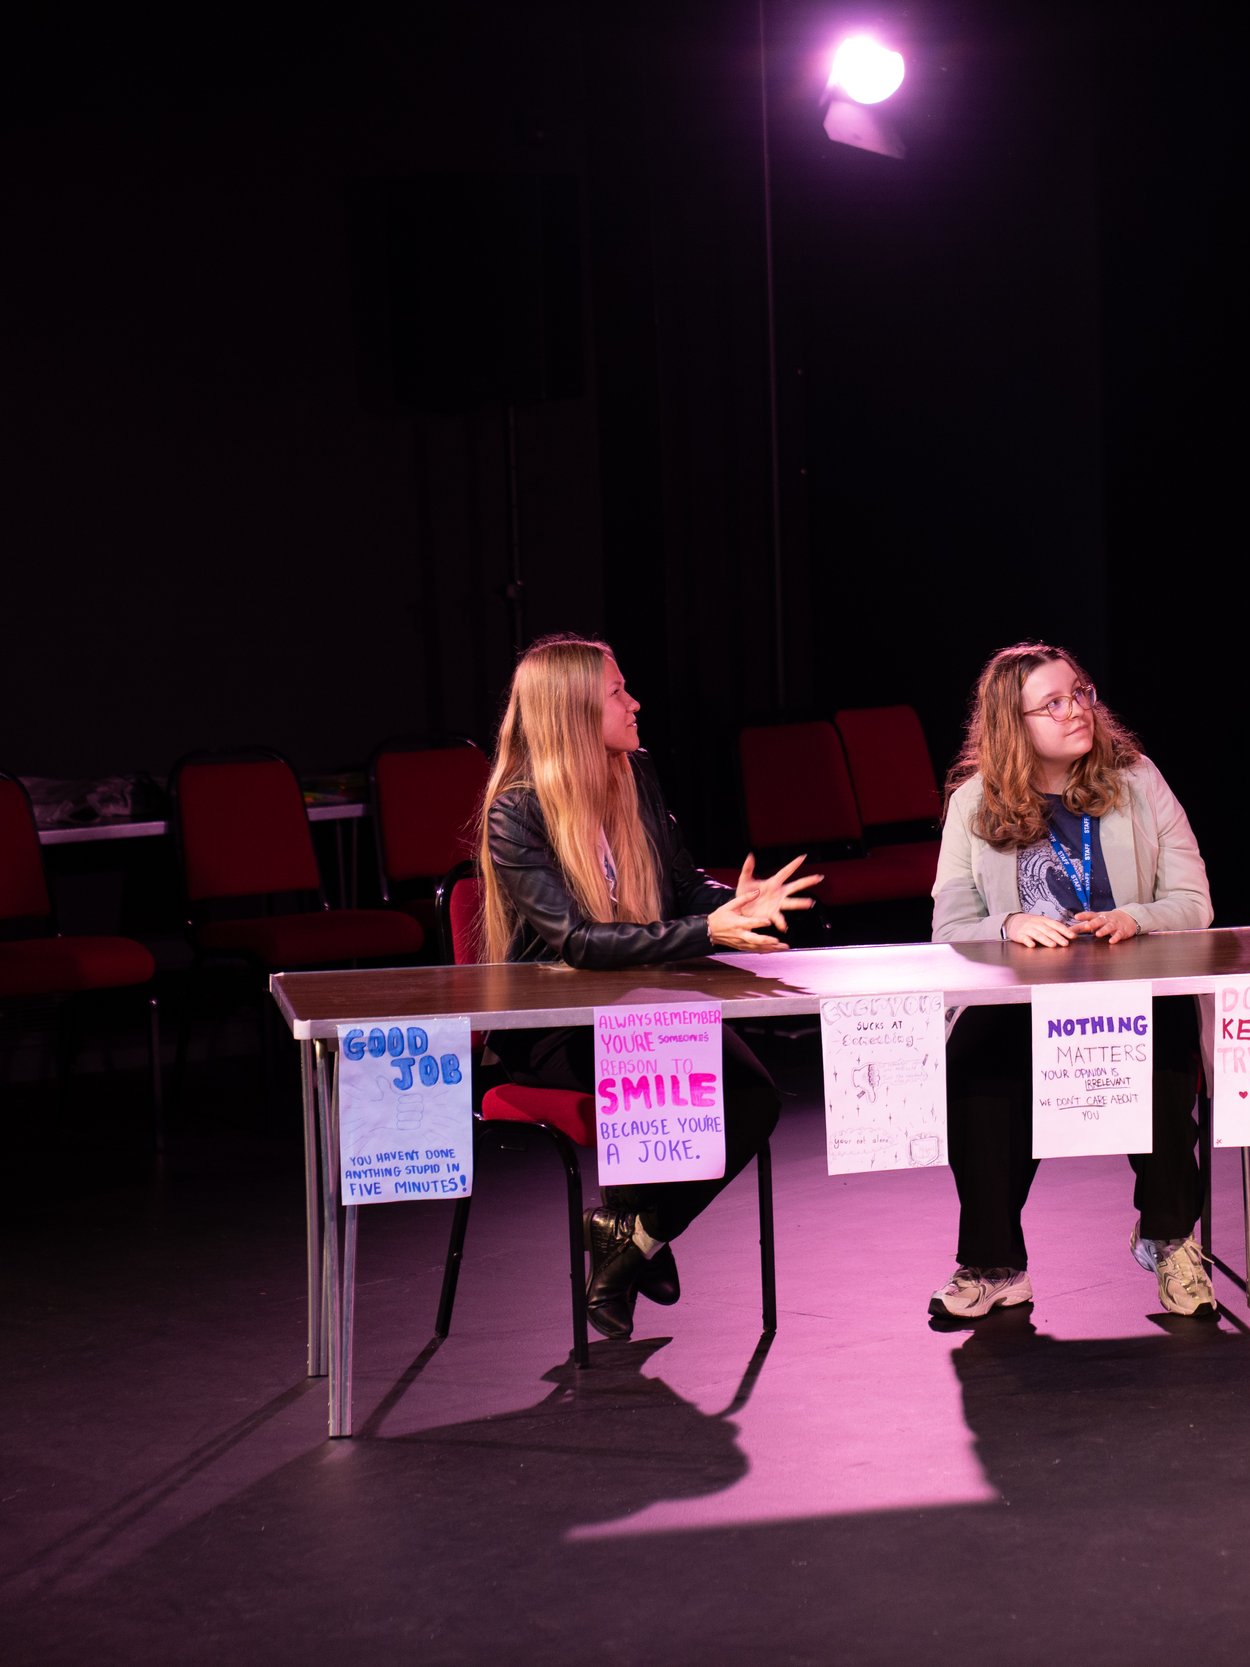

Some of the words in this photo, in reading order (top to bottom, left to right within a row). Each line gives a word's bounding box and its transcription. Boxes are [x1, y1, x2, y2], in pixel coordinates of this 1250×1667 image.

[1057, 850, 1070, 865] STAFF
[1070, 874, 1082, 892] STAFF
[599, 1013, 650, 1029] ALWAYS
[654, 1010, 721, 1026] REMEMBER
[891, 1021, 903, 1029] AT
[1048, 1015, 1148, 1038] NOTHING
[343, 1026, 428, 1061] GOOD
[1057, 1044, 1147, 1066] MATTERS
[390, 1054, 462, 1090] JOB
[600, 1059, 657, 1076] REASON
[672, 1058, 693, 1074] TO
[1041, 1069, 1069, 1080] YOUR
[1074, 1067, 1107, 1079] OPINION
[1111, 1068, 1119, 1076] IS
[1085, 1077, 1131, 1090] IRRELEVANT
[598, 1073, 717, 1115] SMILE
[1039, 1098, 1051, 1106] WE
[1086, 1095, 1107, 1105] CARE
[1111, 1093, 1138, 1104] ABOUT
[1082, 1110, 1100, 1120] YOU
[600, 1118, 669, 1139] BECAUSE
[350, 1155, 372, 1166] YOU
[426, 1149, 456, 1160] DONE
[607, 1143, 619, 1165] A
[638, 1139, 700, 1163] JOKE.
[345, 1167, 401, 1179] ANYTHING
[405, 1164, 440, 1175] STUPID
[447, 1163, 460, 1173] IN
[350, 1183, 382, 1196] FIVE
[395, 1174, 466, 1194] MINUTES!
